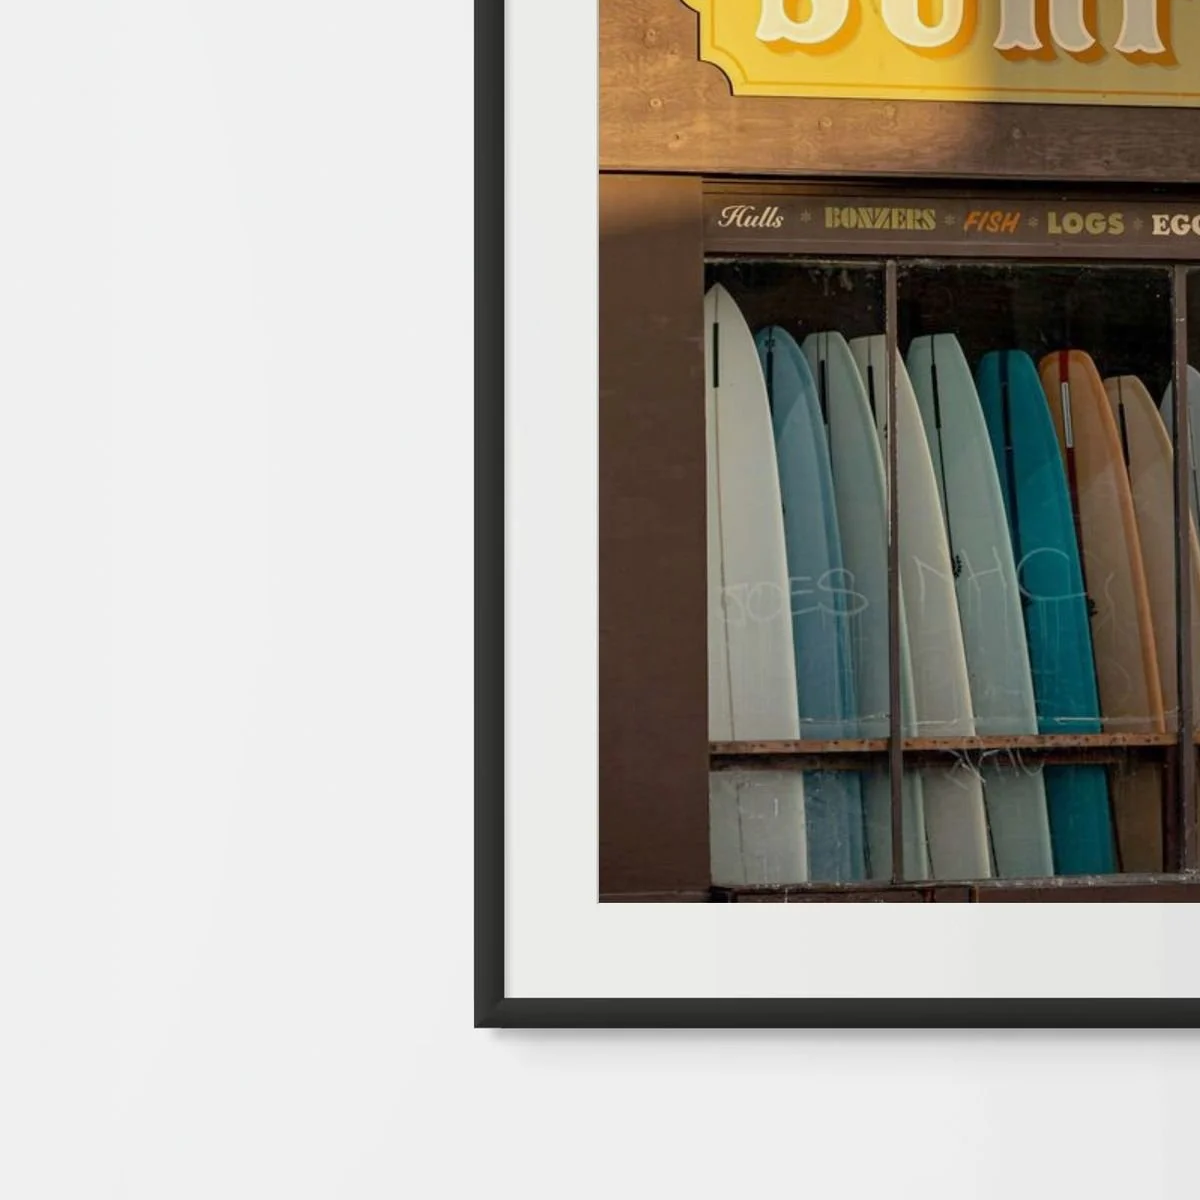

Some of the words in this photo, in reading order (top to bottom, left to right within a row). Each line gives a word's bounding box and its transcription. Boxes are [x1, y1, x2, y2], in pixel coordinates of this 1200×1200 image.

[718, 204, 785, 229] Hulls
[824, 206, 936, 231] BONZERS
[963, 211, 1021, 233] FISH
[1047, 211, 1125, 235] LOGS
